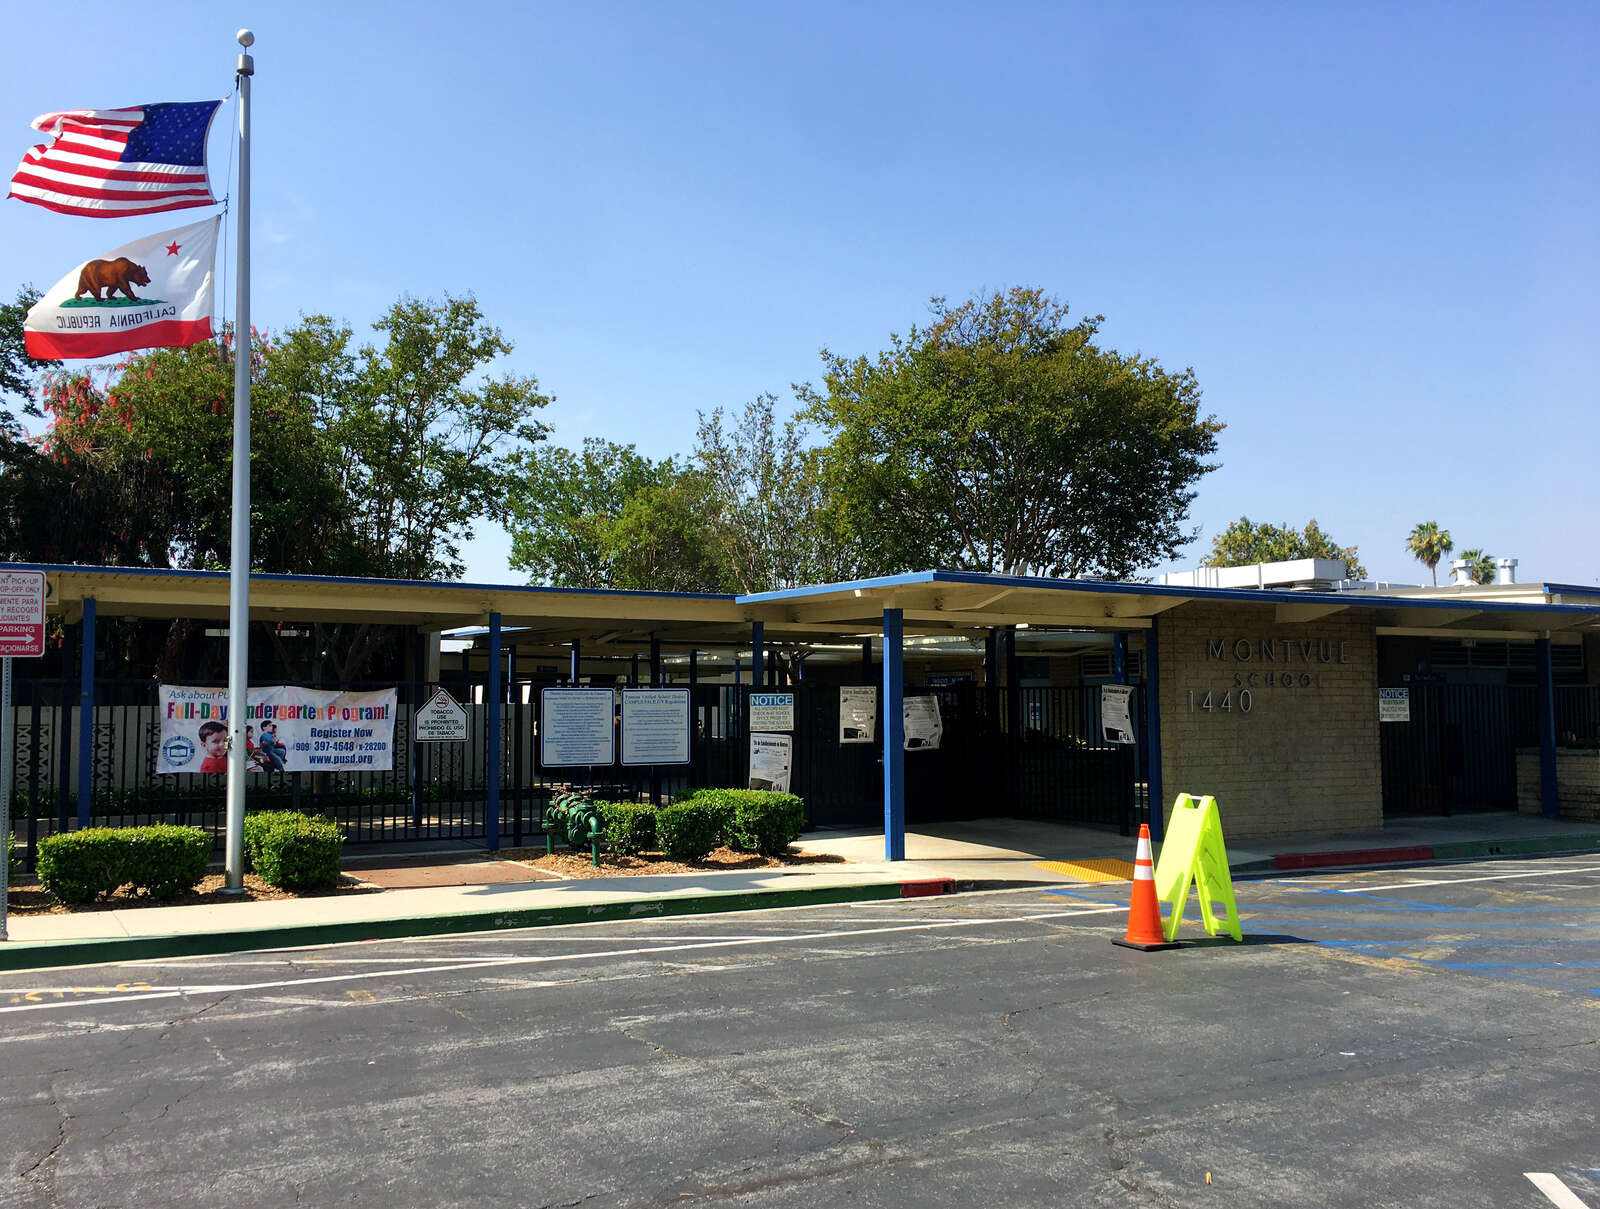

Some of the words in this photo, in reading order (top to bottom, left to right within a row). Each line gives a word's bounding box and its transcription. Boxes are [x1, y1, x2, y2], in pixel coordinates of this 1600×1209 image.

[12, 577, 38, 585] PICK-UP
[25, 586, 40, 594] ONLY
[1207, 638, 1352, 664] MONTVUE
[169, 690, 186, 699] Ask
[188, 690, 215, 700] about
[1380, 689, 1408, 698] NOTICE
[752, 696, 792, 706] NOTICE
[1188, 688, 1252, 713] 1440
[168, 702, 228, 721] Full-Day
[246, 702, 325, 721] ndergarten
[328, 704, 390, 722] Program!
[310, 728, 352, 738] Register
[354, 728, 373, 738] Now
[314, 741, 354, 752] 397-4648
[309, 754, 373, 765] www.pusd.org
